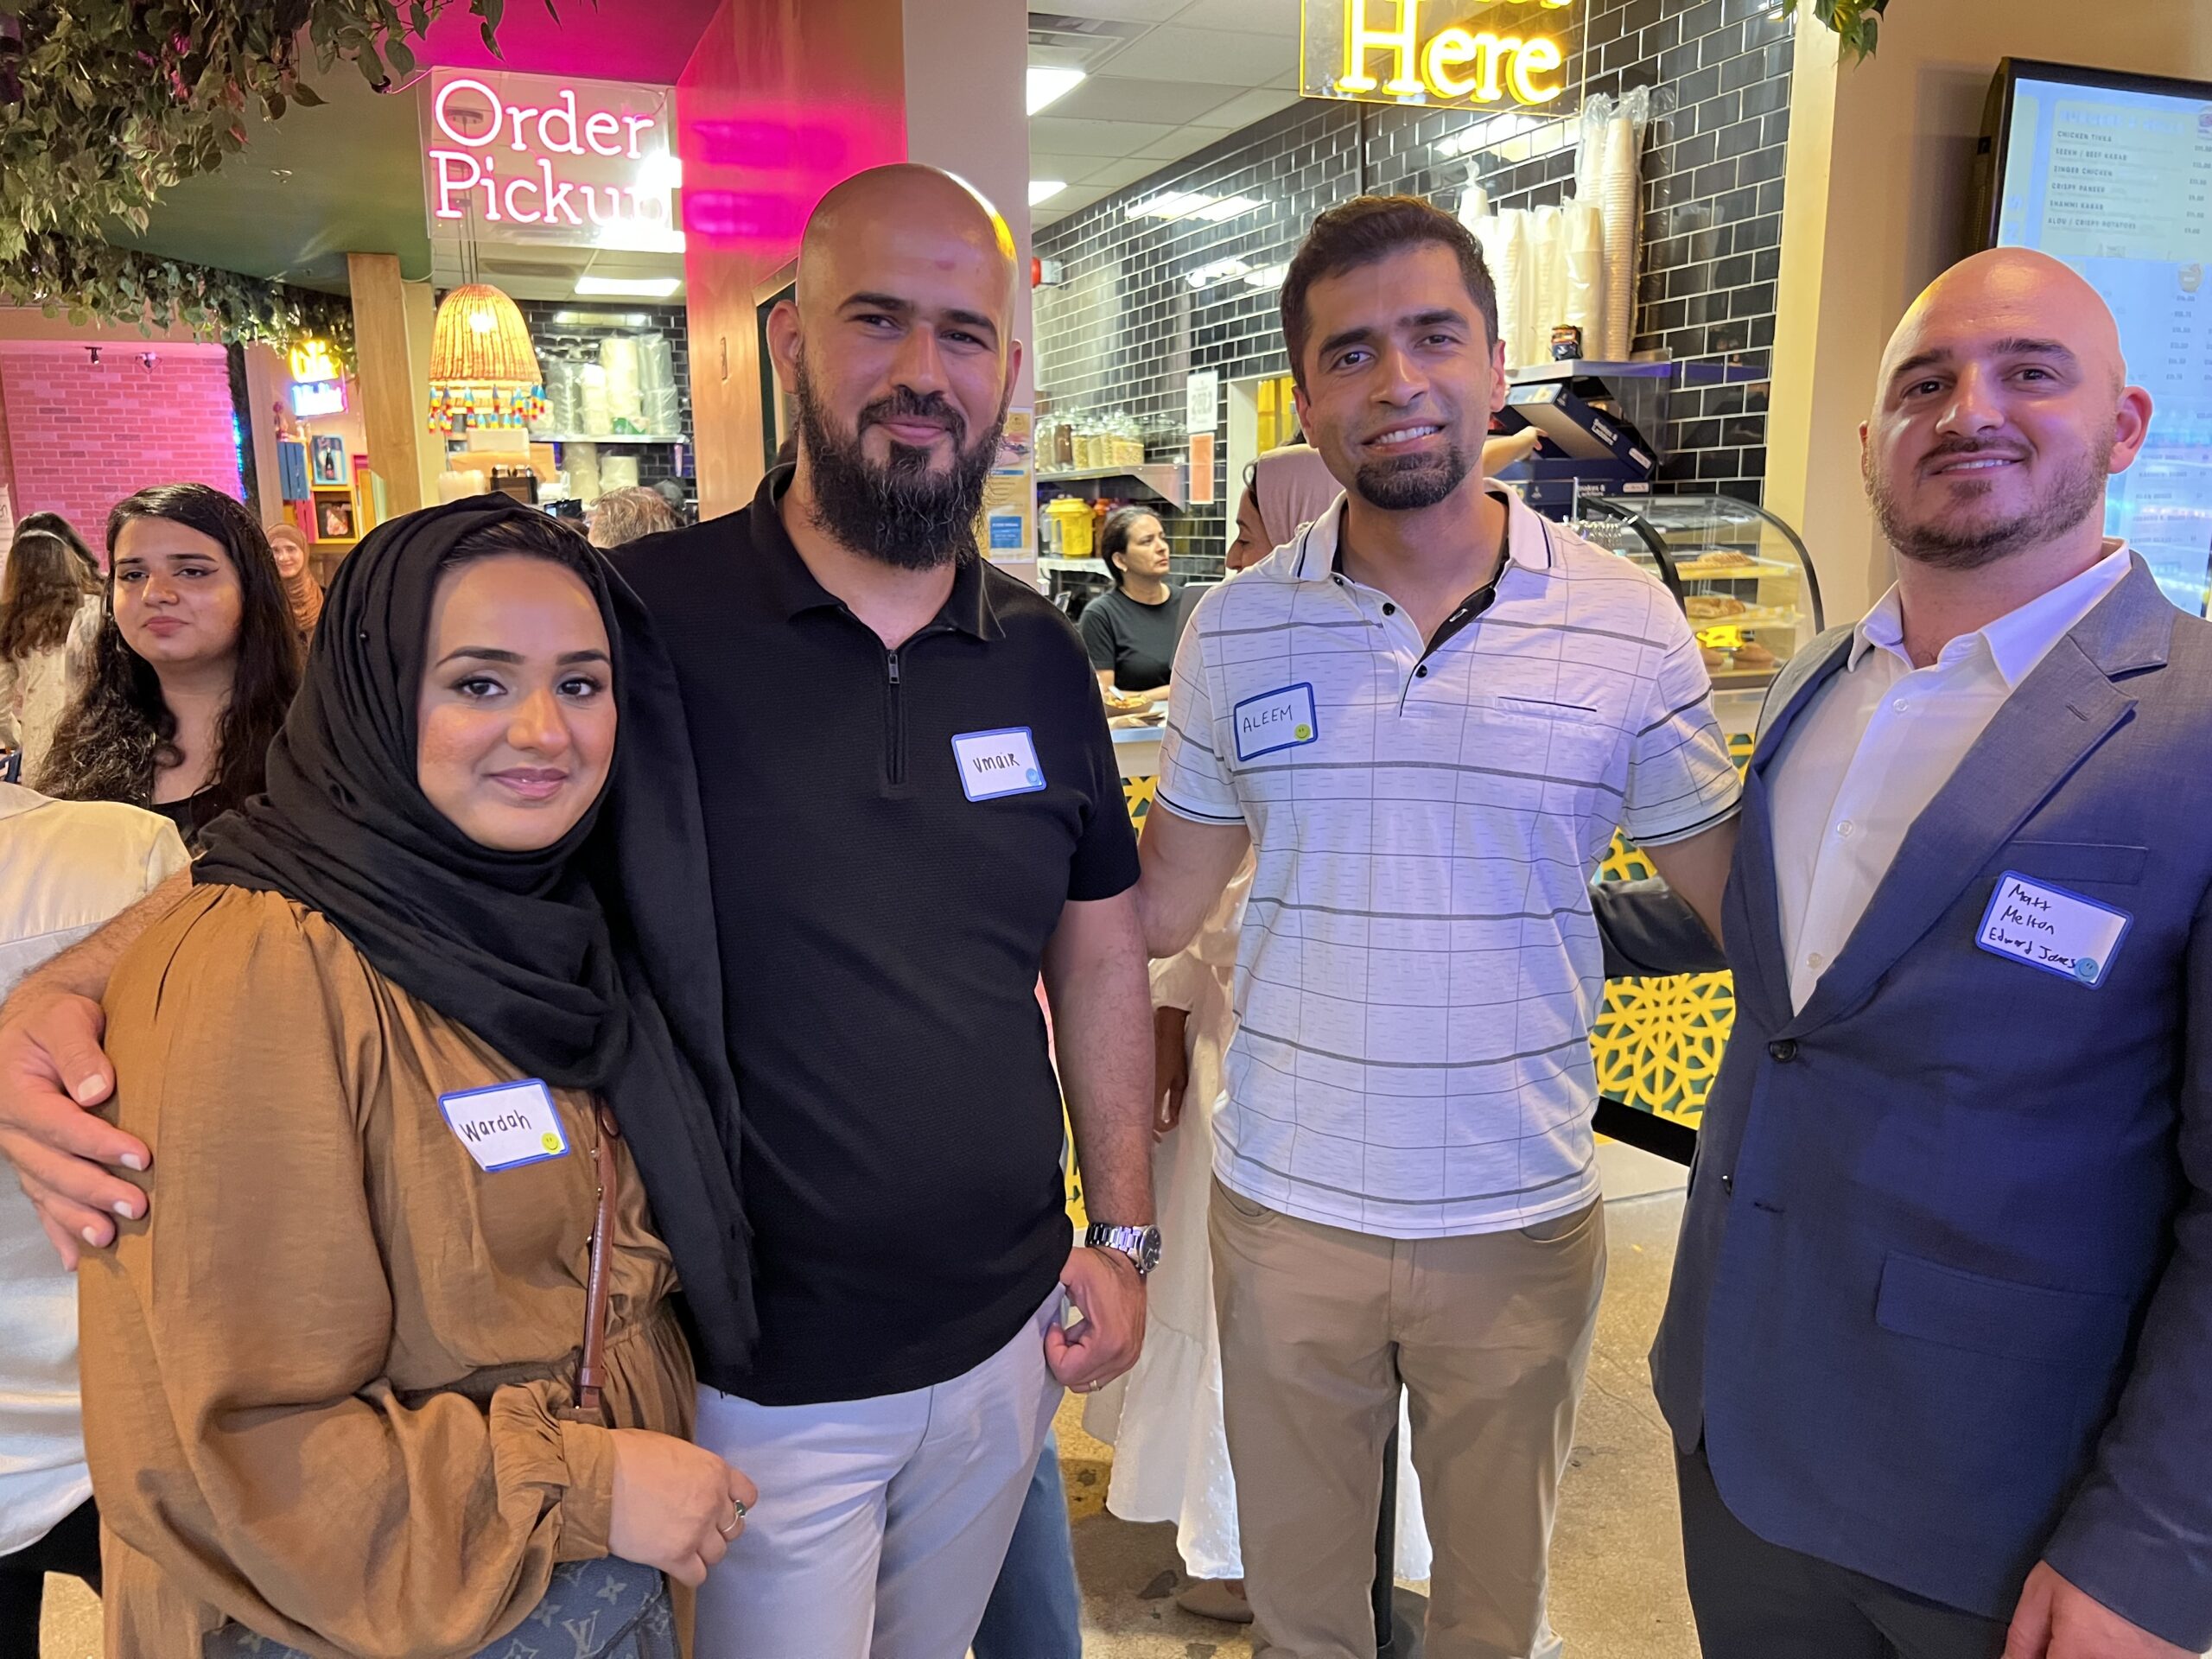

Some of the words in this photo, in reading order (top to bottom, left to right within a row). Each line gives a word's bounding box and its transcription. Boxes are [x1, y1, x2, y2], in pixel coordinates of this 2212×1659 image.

[1333, 0, 1561, 105] Here
[435, 79, 655, 159] Order
[2056, 130, 2089, 141] CHICKEN
[2051, 182, 2076, 192] CRISPY
[2082, 168, 2113, 177] CHICKEN
[1243, 704, 1294, 734] ALEEM
[2007, 883, 2052, 911] Matt
[2000, 906, 2055, 935] Melton
[1988, 926, 2033, 954] Edward
[2037, 945, 2076, 969] Jones
[459, 1109, 532, 1142] Wardah
